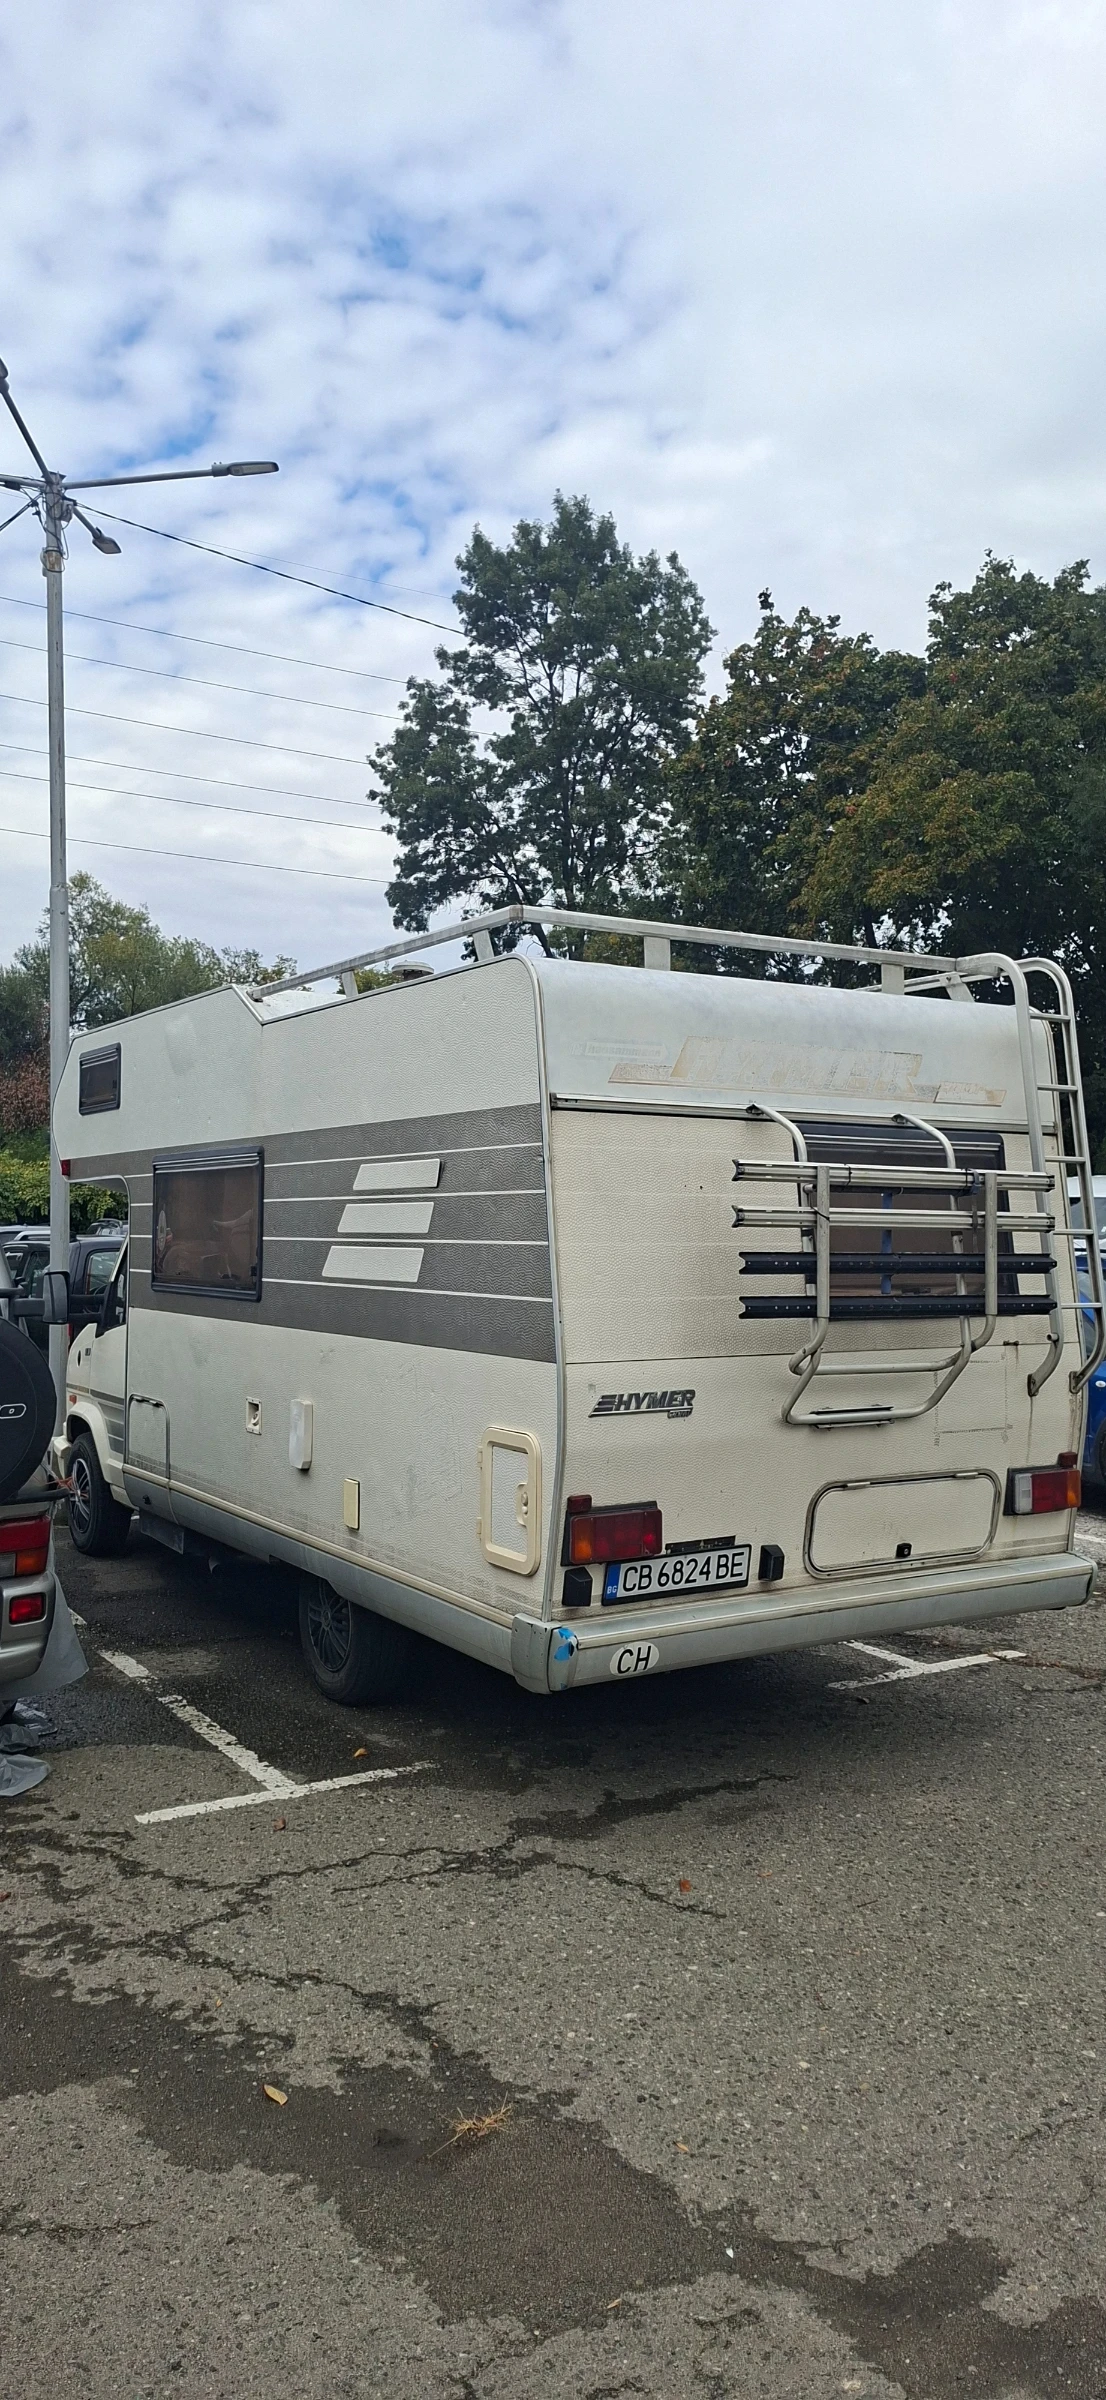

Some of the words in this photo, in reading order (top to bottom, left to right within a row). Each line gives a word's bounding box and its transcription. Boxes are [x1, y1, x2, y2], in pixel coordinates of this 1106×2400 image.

[612, 1389, 696, 1412] HYMER
[622, 1564, 653, 1592] CB
[657, 1555, 712, 1588] 6824
[715, 1551, 745, 1580] BE
[606, 1585, 618, 1595] BG
[617, 1645, 652, 1674] CH
